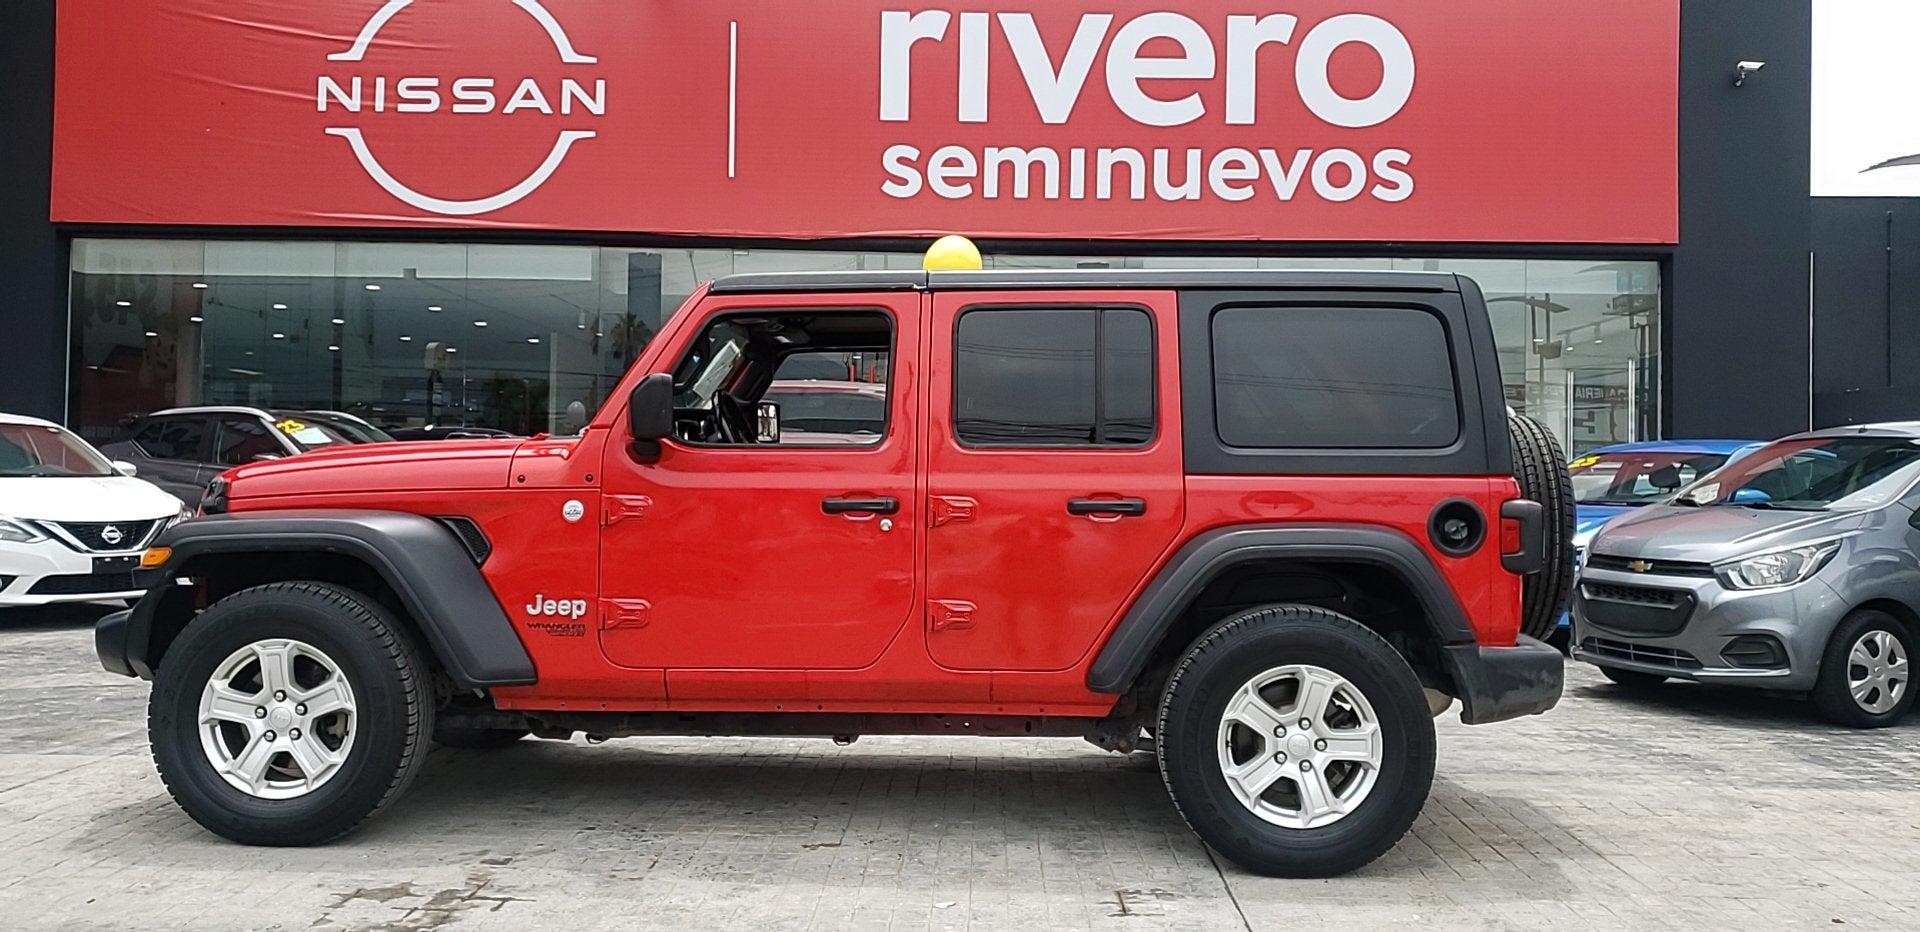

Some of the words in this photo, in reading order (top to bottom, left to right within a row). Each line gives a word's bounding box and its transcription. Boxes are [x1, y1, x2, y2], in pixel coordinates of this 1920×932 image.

[879, 10, 1415, 127] rivero
[317, 76, 605, 115] NISSAN
[881, 144, 1414, 202] seminuevos
[526, 594, 587, 620] Jeep
